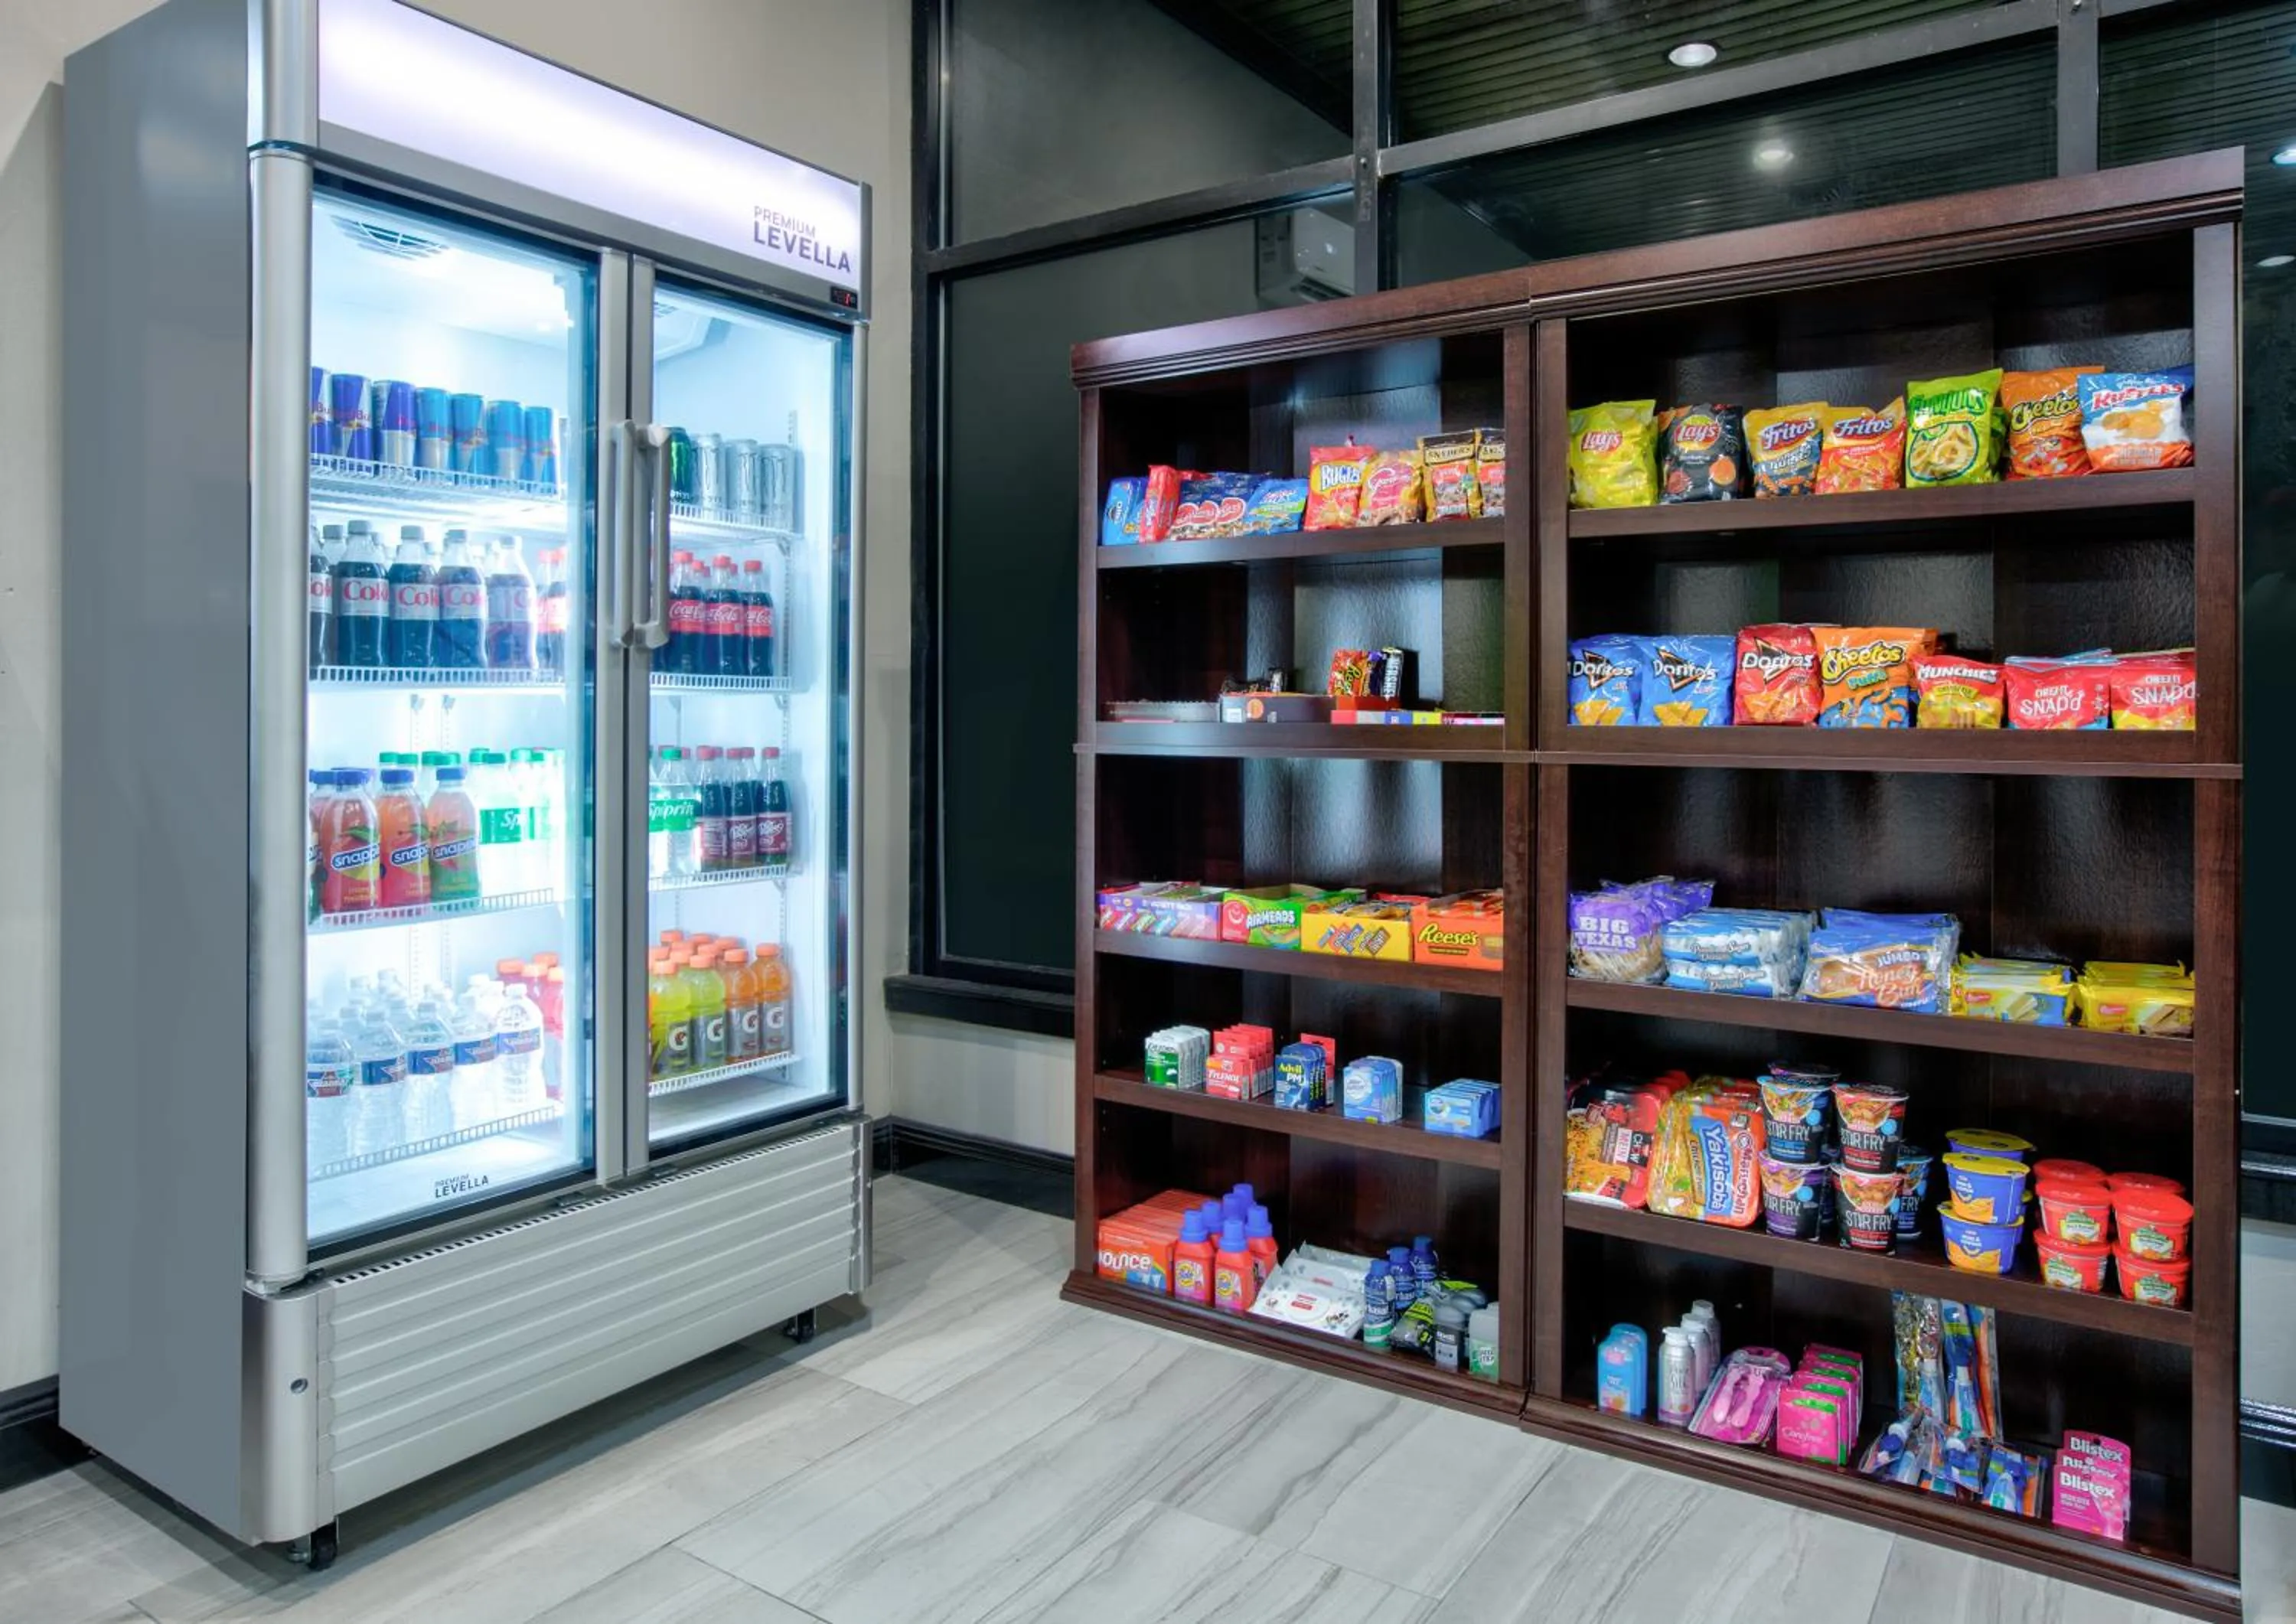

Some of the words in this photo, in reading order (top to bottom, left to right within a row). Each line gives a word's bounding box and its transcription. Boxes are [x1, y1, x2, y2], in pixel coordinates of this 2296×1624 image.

[753, 204, 816, 238] PREMIUM
[753, 220, 851, 273] LEVELLA
[2011, 394, 2080, 430] Cheeto
[1761, 417, 1816, 450] Fritos
[1834, 417, 1893, 438] Fritos
[1573, 659, 1634, 677] Doritos
[1653, 658, 1718, 681] Doritos
[1741, 651, 1815, 670] Doritos
[1821, 644, 1903, 681] Cheetos
[1917, 664, 1998, 683] MUNCHIES
[1246, 910, 1295, 929] AIRHEADS
[1579, 916, 1630, 935] BIG
[1418, 921, 1479, 947] Reese's
[1574, 931, 1637, 949] TEXAS
[1877, 951, 1920, 969] JUMBO
[1278, 1061, 1303, 1074] Advil
[1286, 1072, 1302, 1082] PM
[1789, 1124, 1811, 1142] FRY
[1864, 1132, 1886, 1152] FRY
[1629, 1133, 1644, 1163] CHOW
[1704, 1126, 1730, 1211] Yakisoba
[435, 1175, 489, 1198] LEVELLA
[1763, 1195, 1779, 1213] TIR
[1779, 1197, 1801, 1217] FRY
[1845, 1209, 1870, 1228] STIR
[1870, 1212, 1893, 1231] FRY
[2070, 1436, 2123, 1462] Blistex
[2060, 1471, 2115, 1498] Blistex
